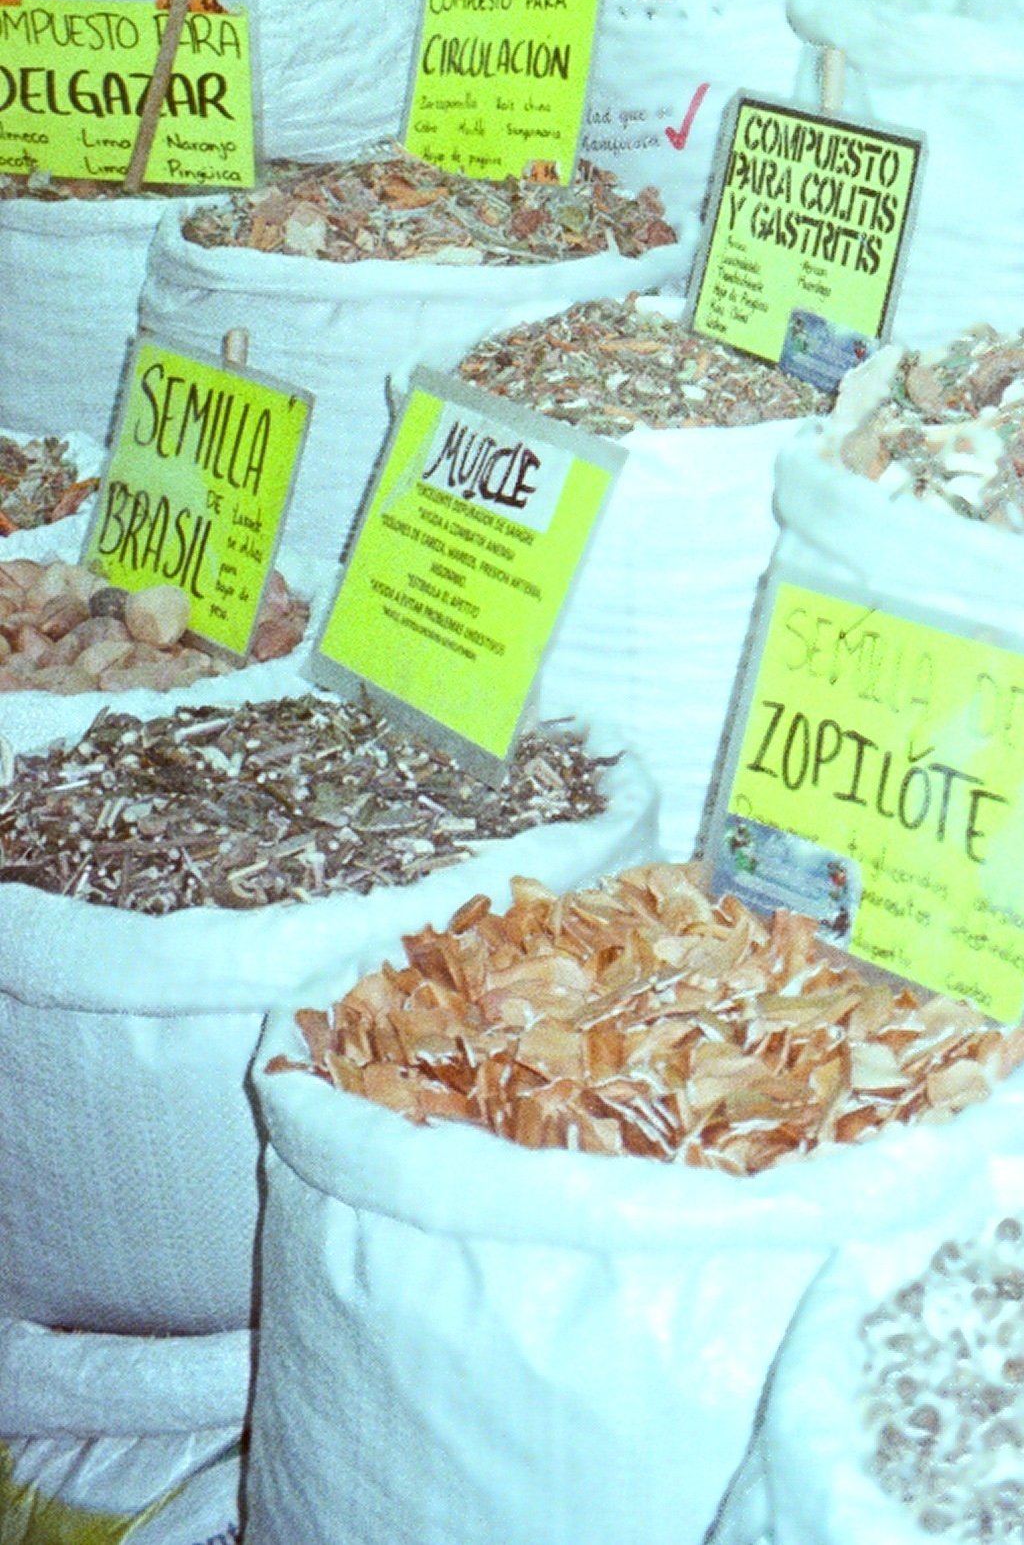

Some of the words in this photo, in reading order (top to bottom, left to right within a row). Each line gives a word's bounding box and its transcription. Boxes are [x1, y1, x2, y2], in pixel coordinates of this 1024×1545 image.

[0, 7, 139, 51] MPUESTO
[727, 150, 792, 204] PARA
[800, 171, 898, 235] COLITIS
[744, 114, 900, 188] COMPUESTO
[729, 191, 746, 231] Y
[750, 202, 883, 275] GASTRITIS
[134, 363, 271, 497] SEMILLA
[99, 481, 213, 599] BRASIL
[746, 700, 1008, 865] ZOPILOTE
